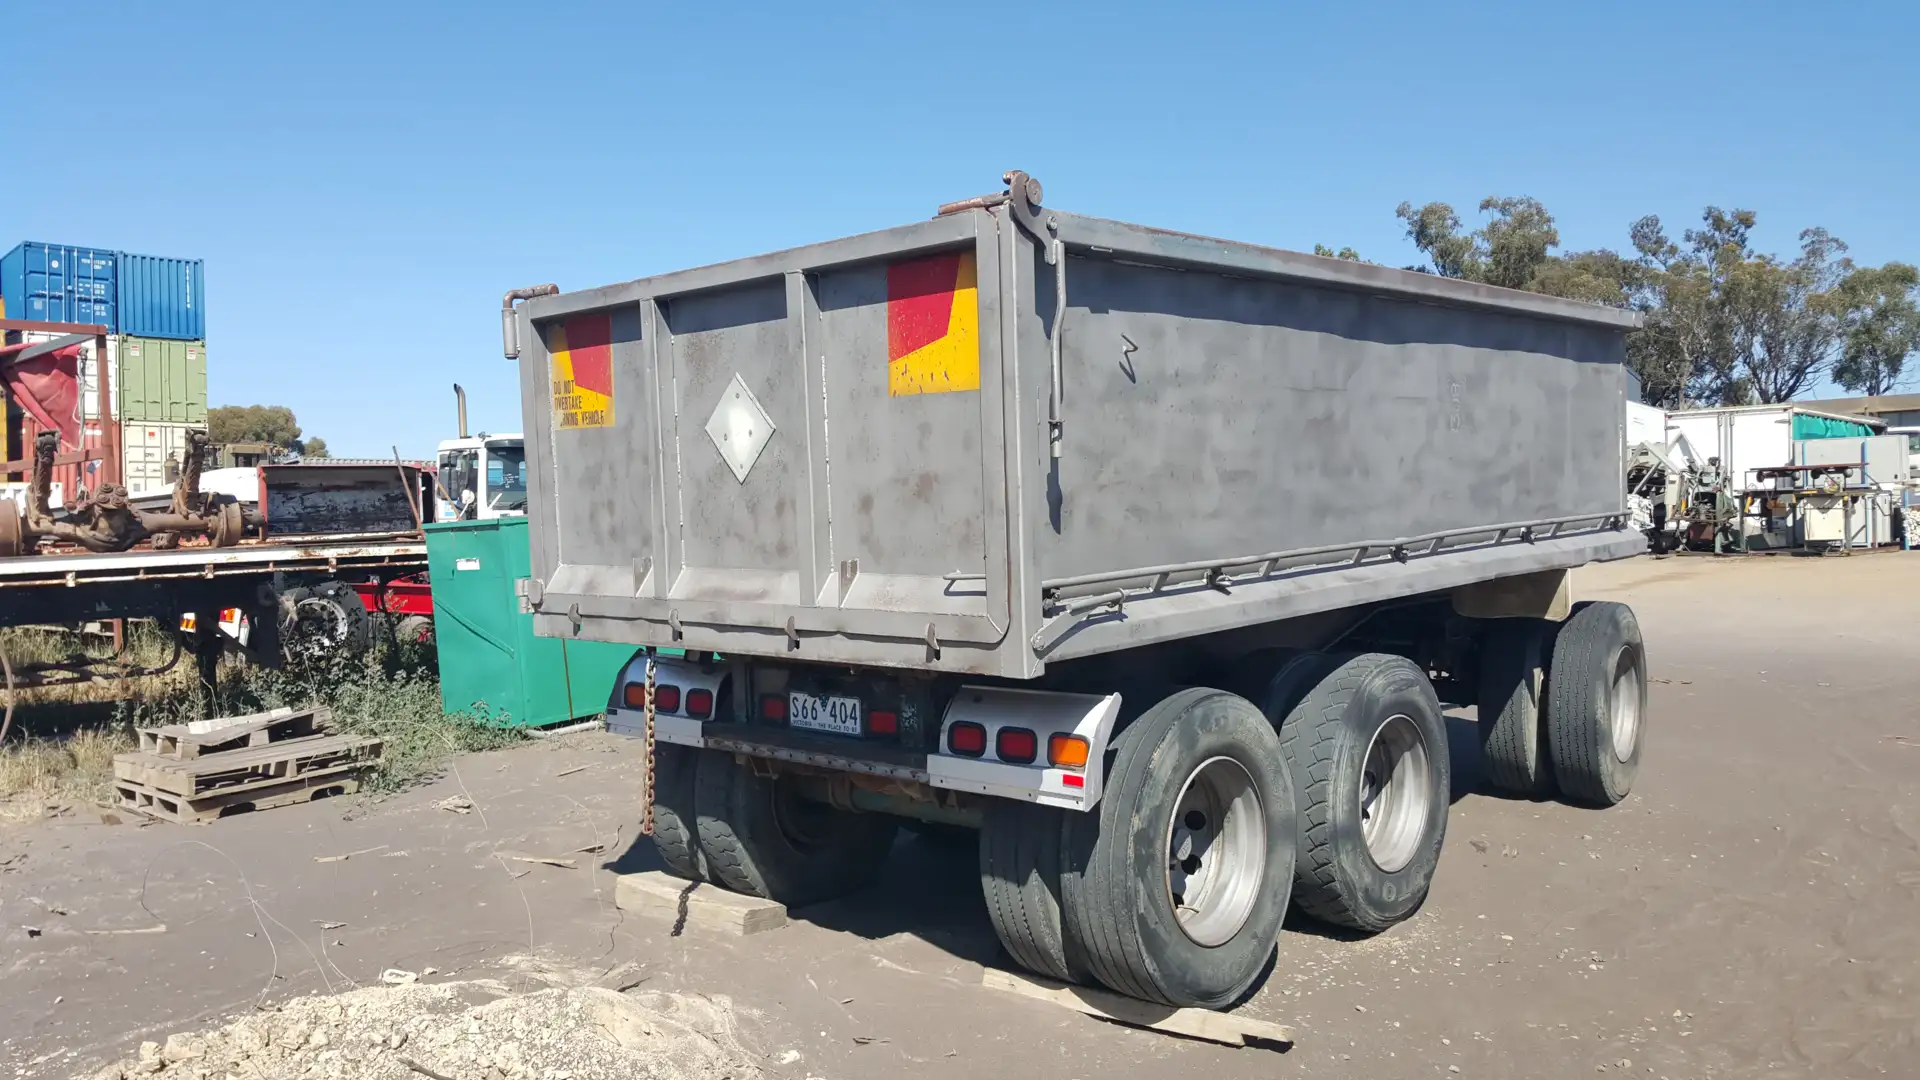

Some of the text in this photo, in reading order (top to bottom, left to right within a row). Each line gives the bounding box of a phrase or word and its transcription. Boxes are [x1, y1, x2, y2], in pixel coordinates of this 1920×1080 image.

[564, 380, 574, 394] NOT
[555, 396, 582, 411] OVERTAKE
[581, 409, 604, 426] VEHICLE
[792, 697, 858, 726] S66 404
